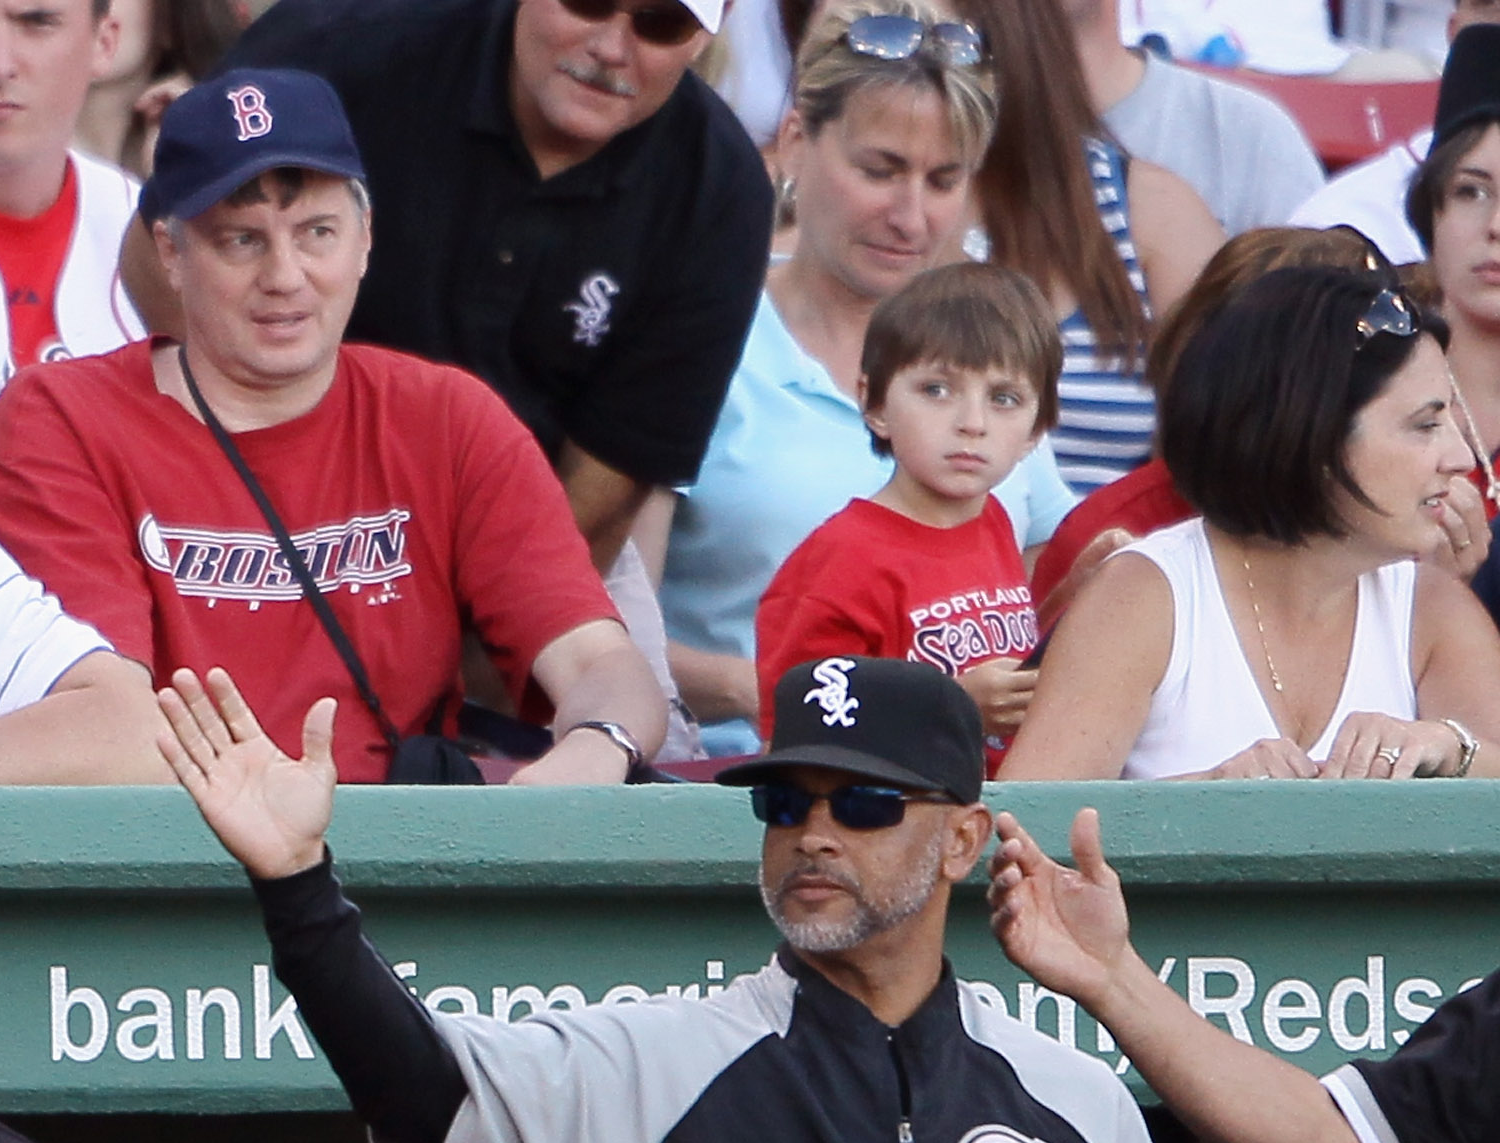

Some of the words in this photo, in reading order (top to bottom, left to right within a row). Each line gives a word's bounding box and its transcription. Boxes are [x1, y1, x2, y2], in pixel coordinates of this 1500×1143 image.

[227, 86, 273, 141] B
[173, 520, 405, 591] BOSTON
[909, 586, 1031, 628] PORTLAND
[914, 619, 990, 679] Sea
